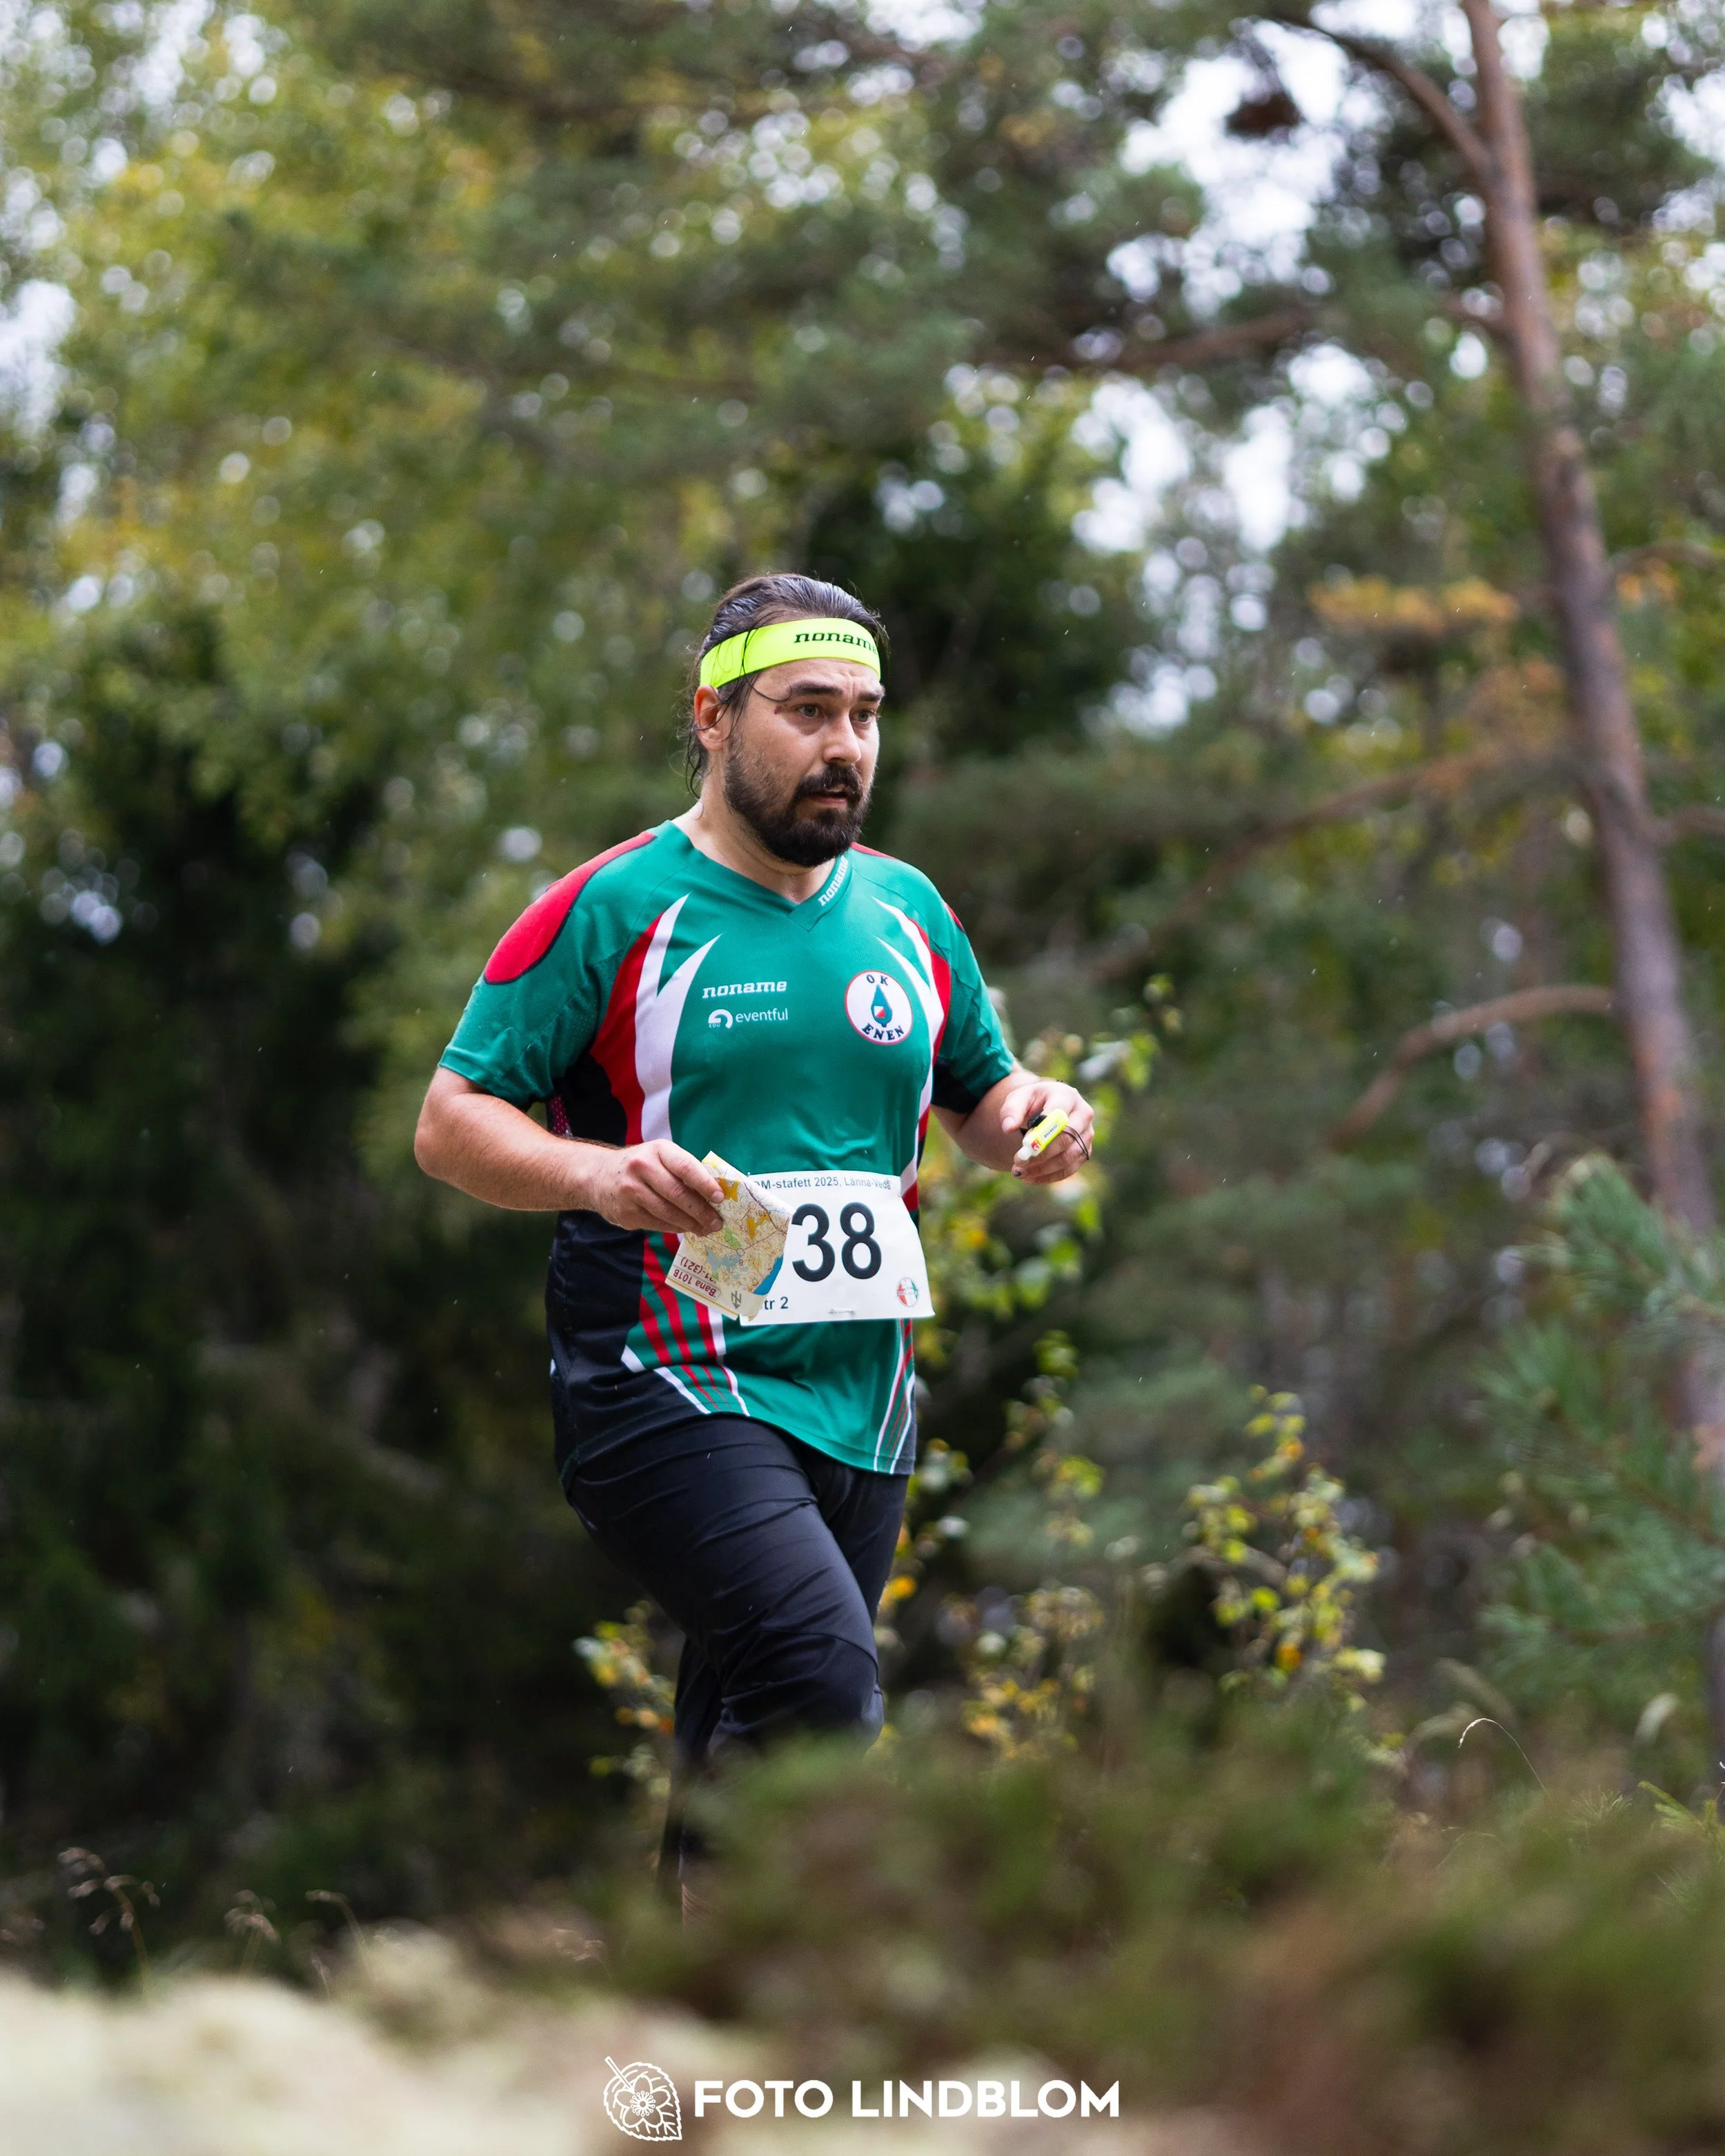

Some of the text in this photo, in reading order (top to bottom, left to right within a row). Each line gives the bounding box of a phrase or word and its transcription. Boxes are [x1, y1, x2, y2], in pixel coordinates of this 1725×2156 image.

[702, 980, 787, 998] noname
[735, 1007, 788, 1023] eventful
[862, 1022, 905, 1041] ENEN
[754, 1177, 811, 1189] M-stafett
[791, 1202, 882, 1283] 38
[680, 1256, 716, 1283] 1-(321)
[673, 1269, 717, 1297] Bana 101B
[762, 1296, 789, 1310] tr 2
